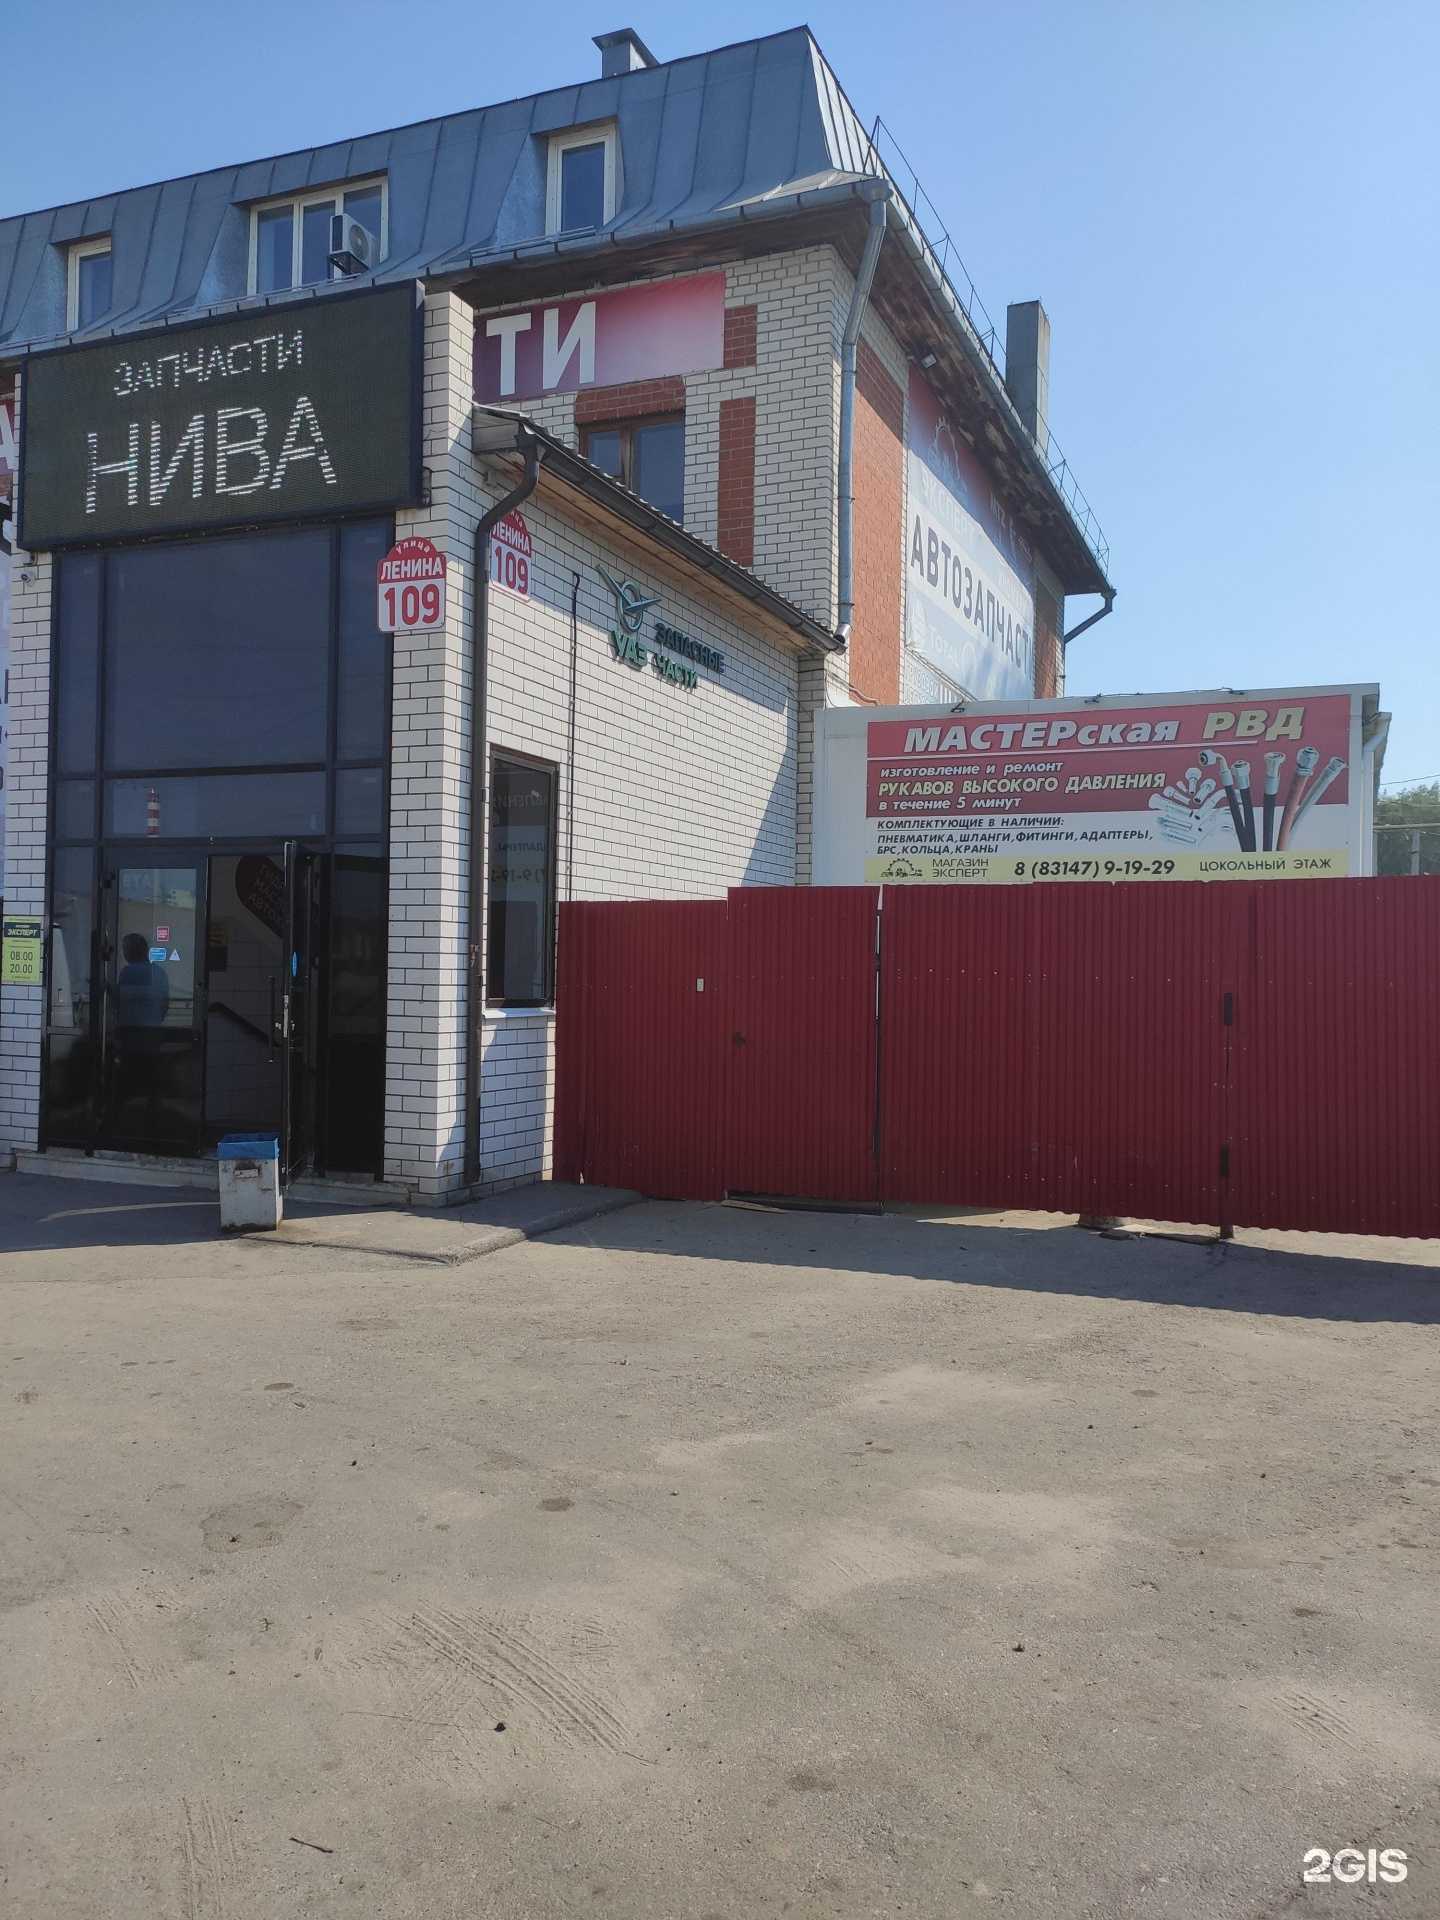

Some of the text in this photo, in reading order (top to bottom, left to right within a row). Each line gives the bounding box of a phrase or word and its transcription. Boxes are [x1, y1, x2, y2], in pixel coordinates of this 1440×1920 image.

[486, 301, 596, 396] ТИ
[113, 330, 302, 396] ЗАПЧАСТИ
[86, 397, 336, 513] НИВА
[492, 520, 530, 554] ЛЕНИНА
[381, 557, 443, 580] ЛЕНИНА
[495, 546, 528, 594] 109
[384, 584, 440, 627] 109
[655, 654, 698, 689] ЧАСТИ
[903, 706, 1305, 753] МАСТЕРская РВД
[880, 761, 1064, 778] изготовление и ремонт
[878, 772, 1166, 796] РУКАВОВ ВЫСОКОГО ДАВЛЕНИЯ
[878, 797, 1022, 811] в течение 5 минут
[877, 816, 1065, 829] КОМПЛЕКТУЮЩИЕ В НАЛИЧИИ:
[932, 858, 989, 867] МАГАЗИН
[932, 868, 988, 878] ЭКСПЕРТ
[1014, 859, 1176, 878] 8 (83147) 9-19-29
[1200, 857, 1332, 872] ЦОКОЛЬНЫЙ ЭТАЖ
[7, 928, 38, 936] ЭКСПЕРТ
